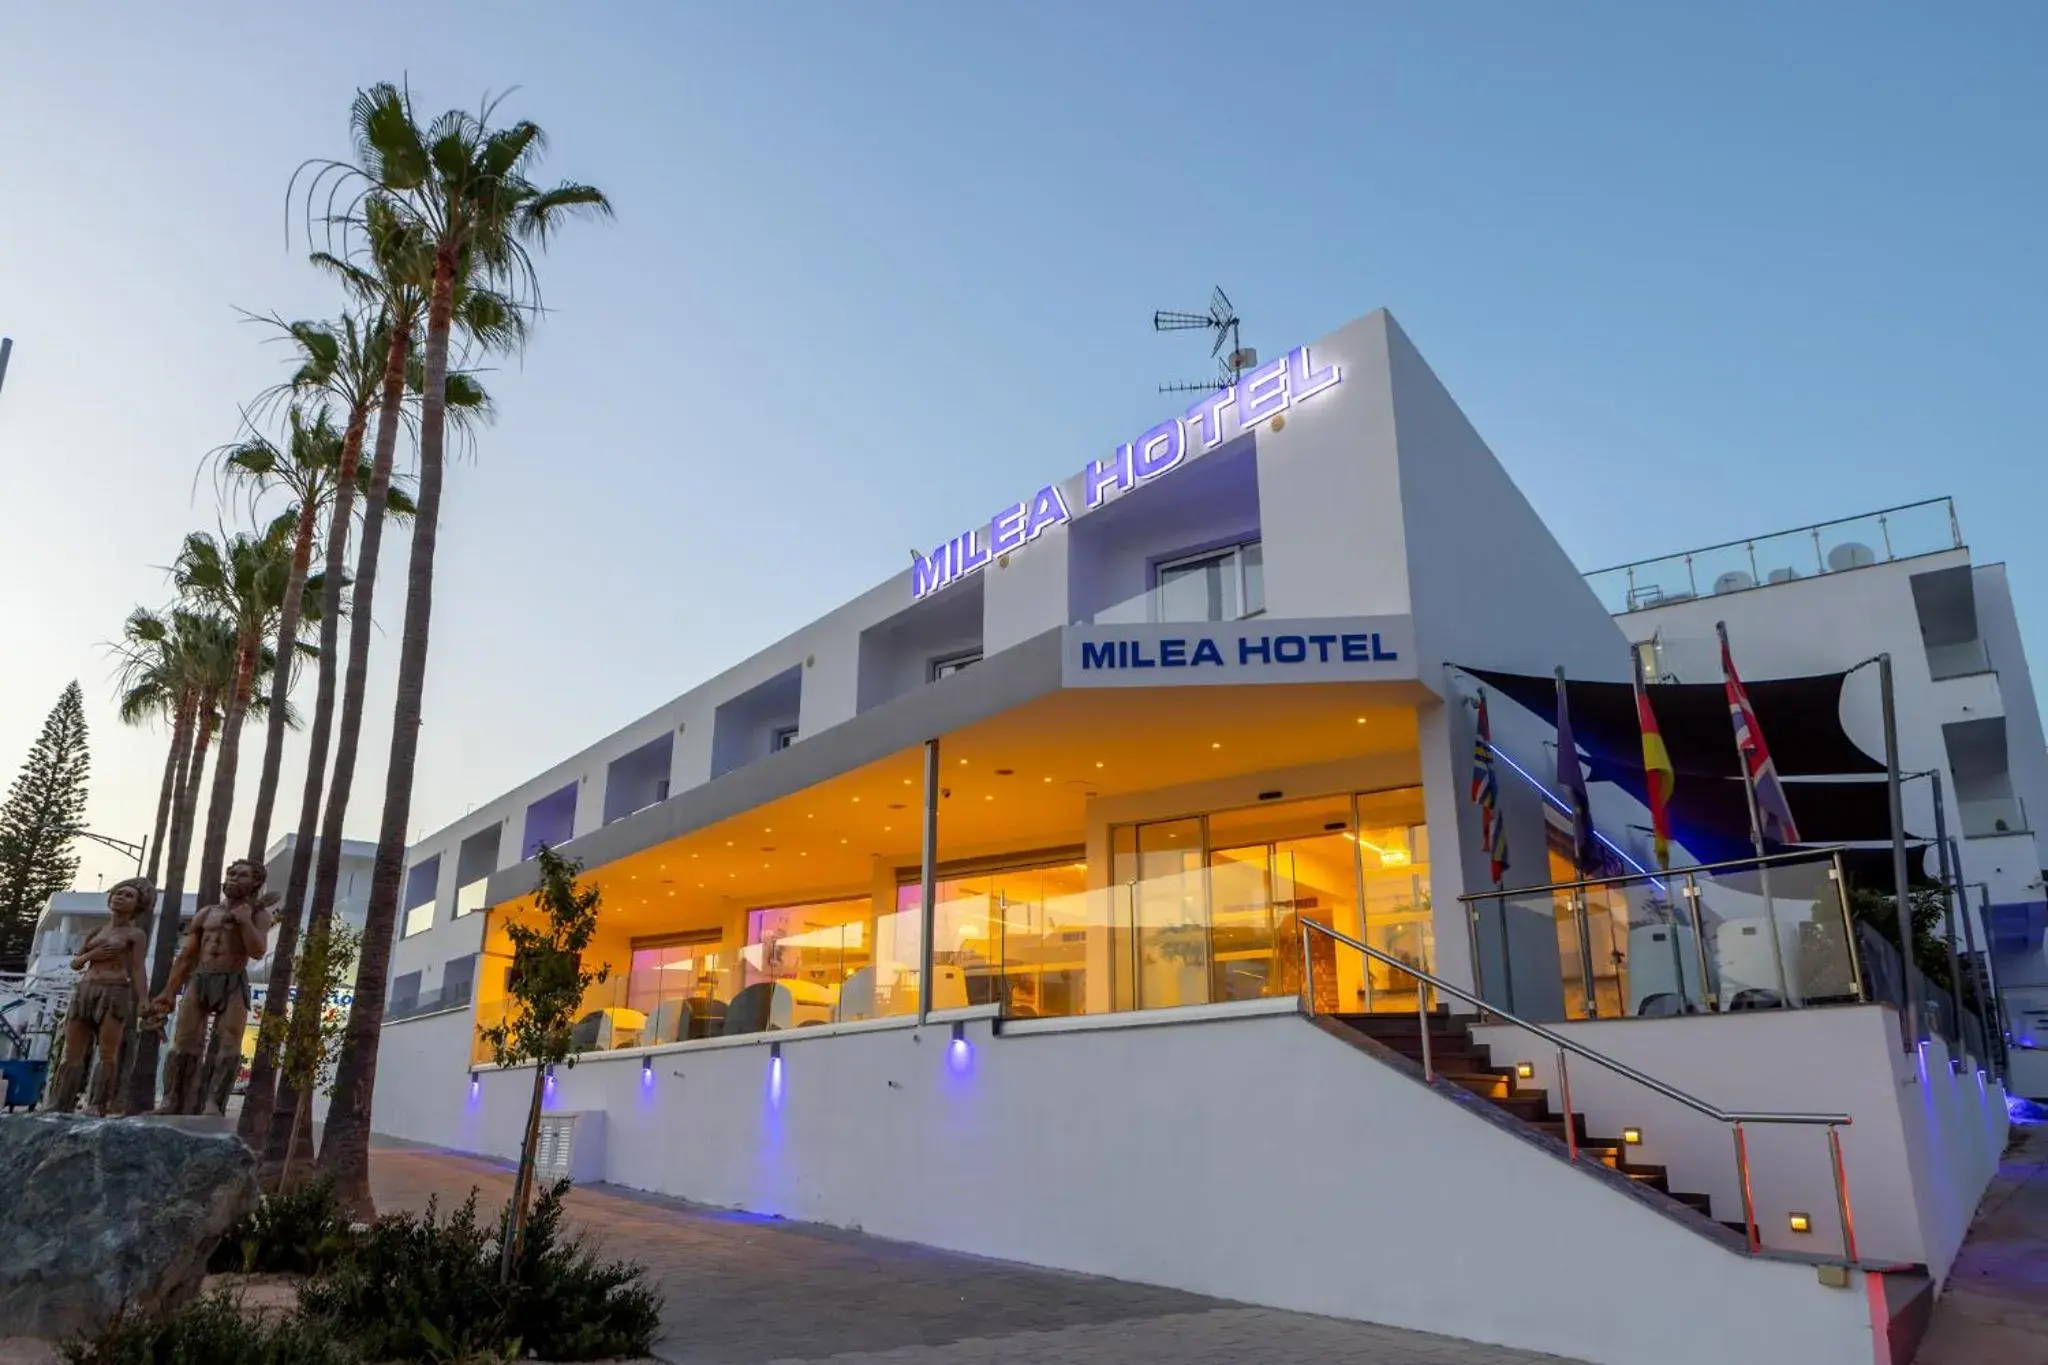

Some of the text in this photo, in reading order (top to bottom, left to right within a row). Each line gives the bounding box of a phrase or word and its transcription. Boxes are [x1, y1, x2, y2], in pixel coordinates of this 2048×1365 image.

[912, 345, 1341, 599] MILEA HOTEL
[1082, 633, 1397, 669] MILEA HOTEL
